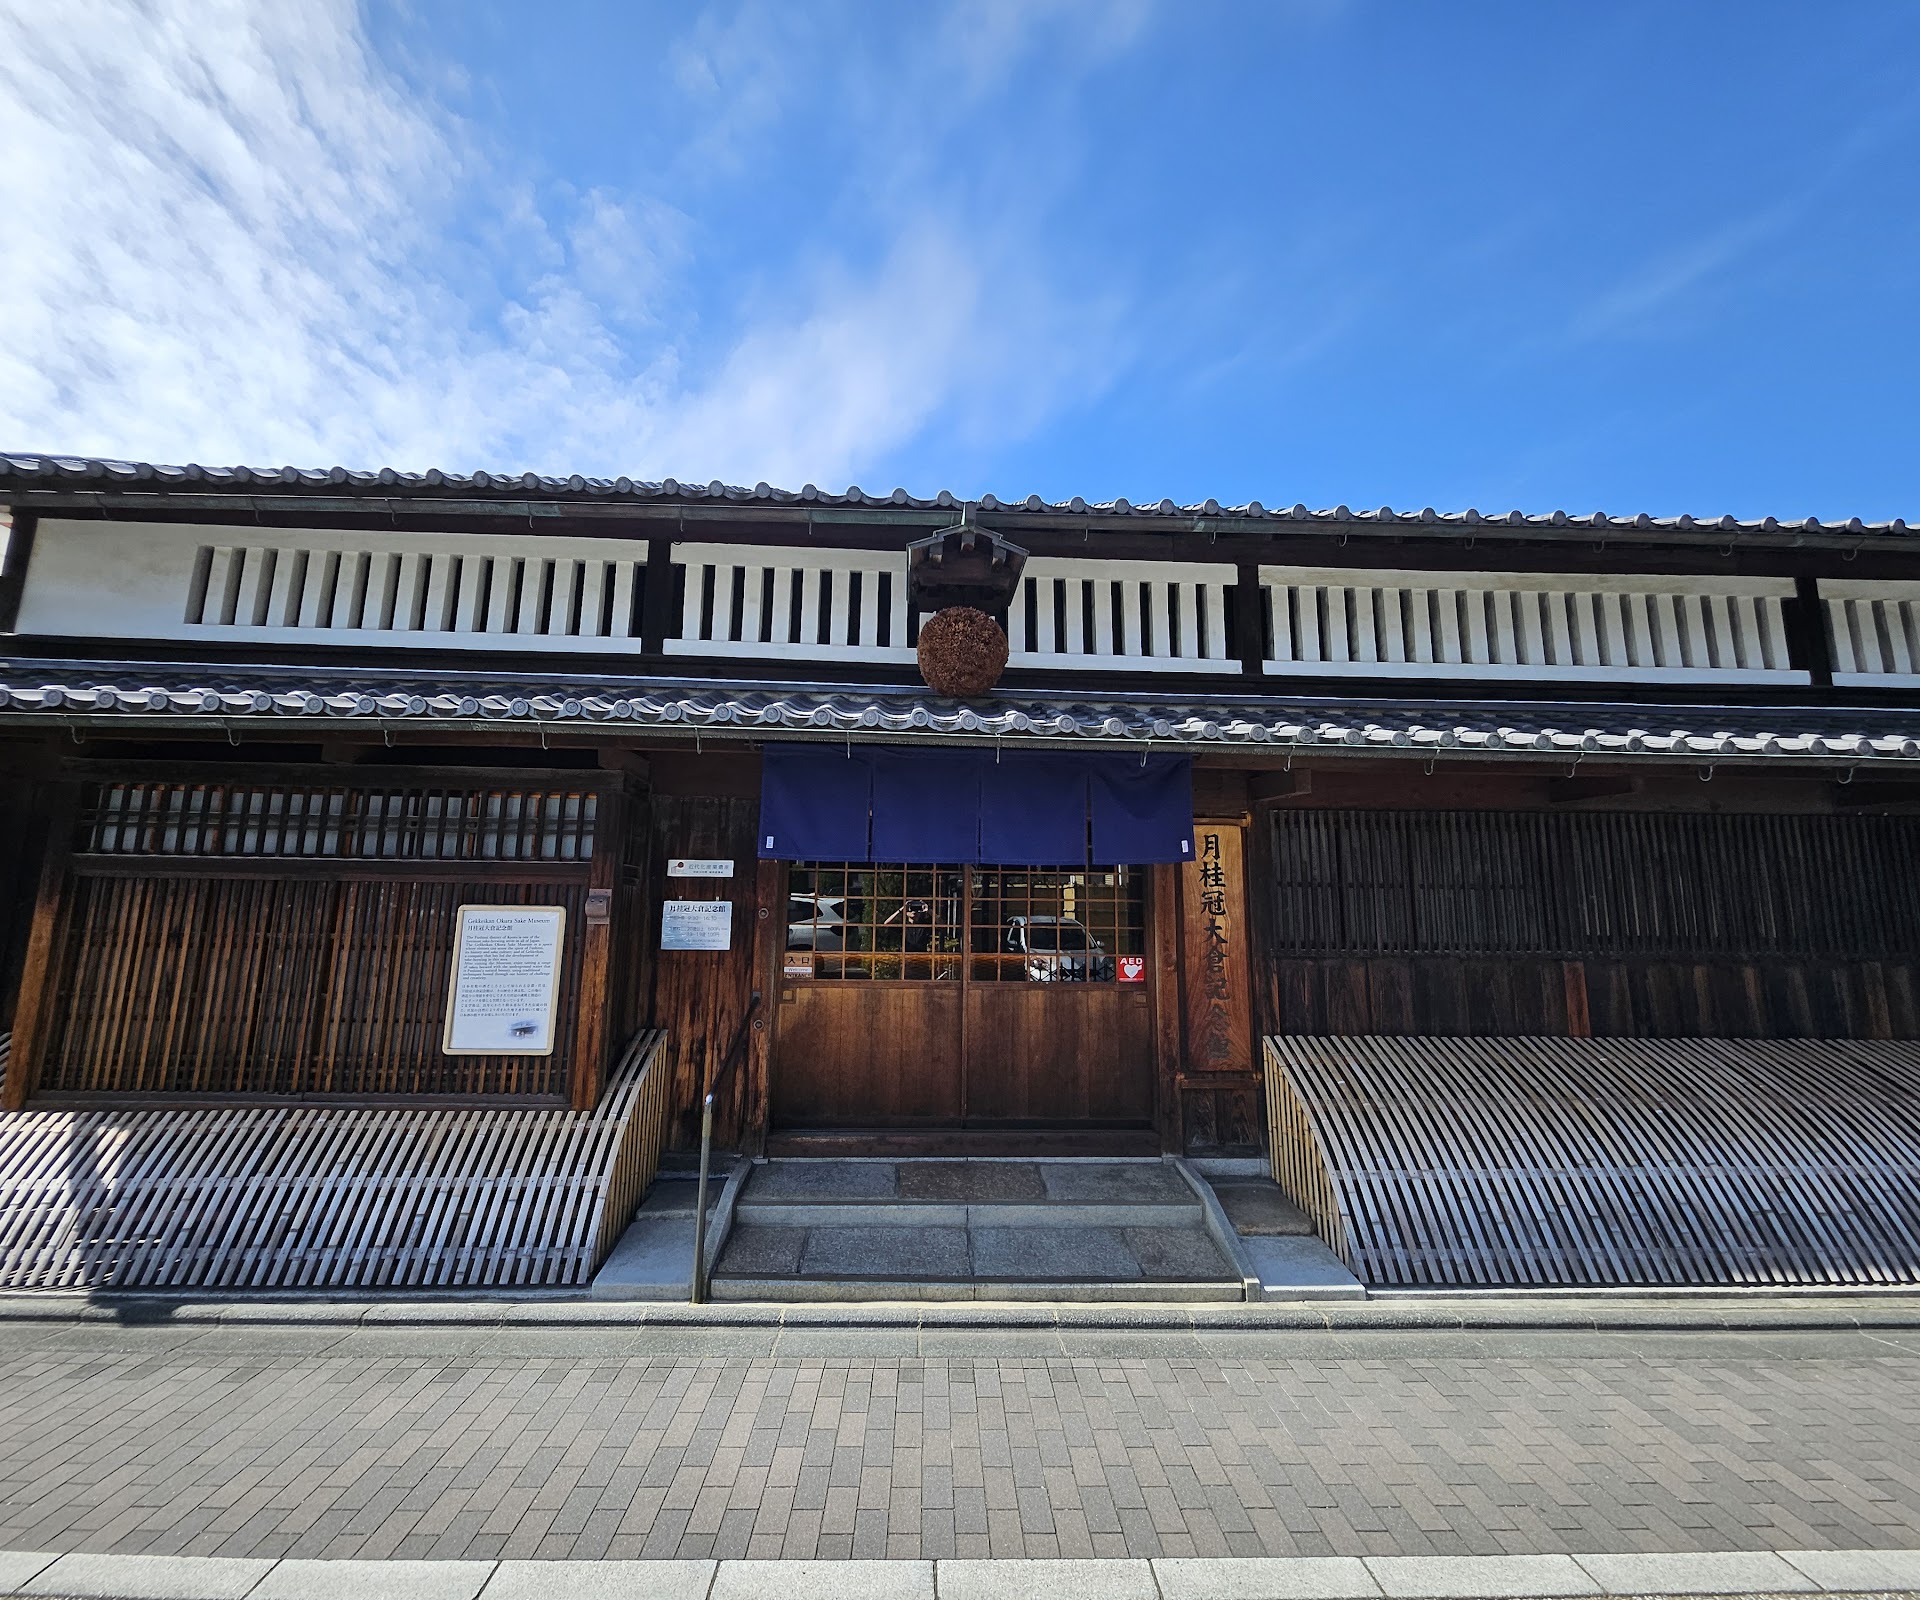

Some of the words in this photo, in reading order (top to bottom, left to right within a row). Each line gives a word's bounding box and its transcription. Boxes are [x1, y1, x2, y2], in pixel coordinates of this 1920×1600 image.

[1198, 833, 1231, 1060] 月桂冠大倉記念館
